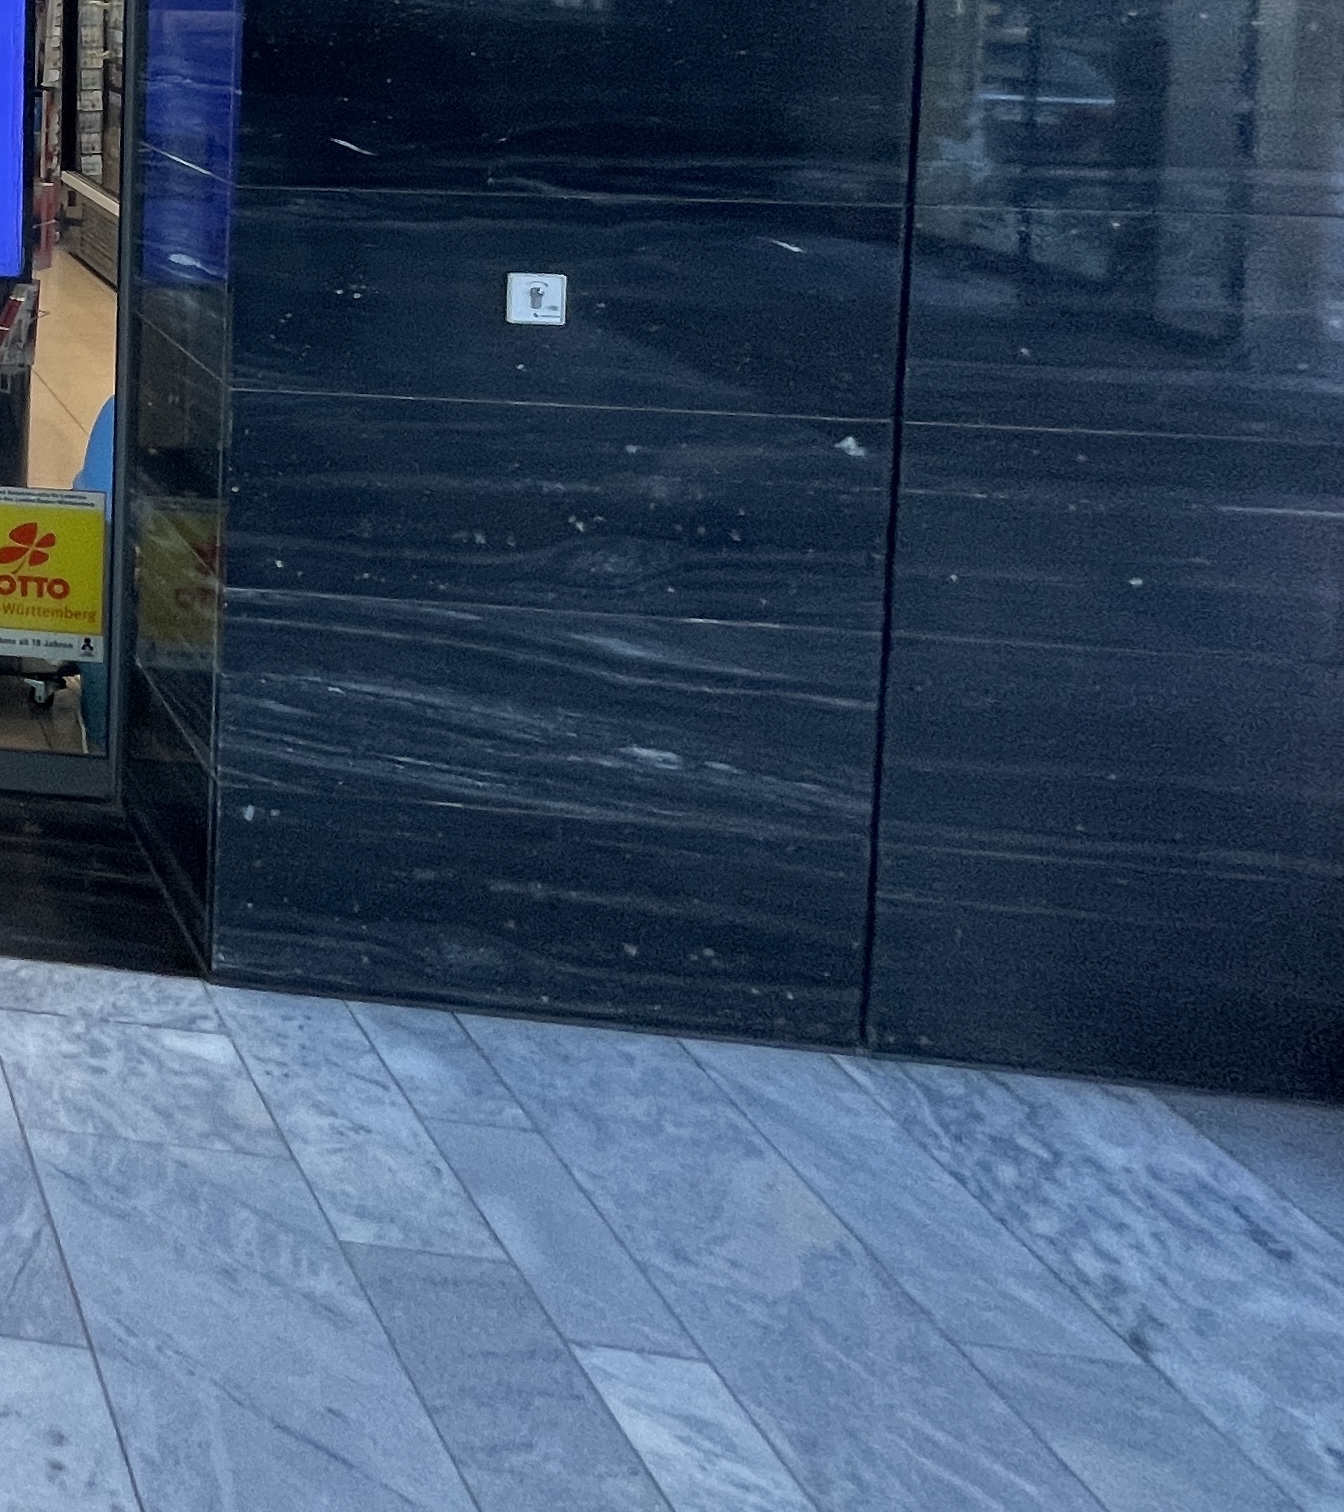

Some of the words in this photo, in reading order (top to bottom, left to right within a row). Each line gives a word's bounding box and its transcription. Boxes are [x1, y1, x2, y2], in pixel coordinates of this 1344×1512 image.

[19, 637, 29, 646] ab
[32, 639, 41, 647] 18
[43, 639, 73, 650] Jahren
